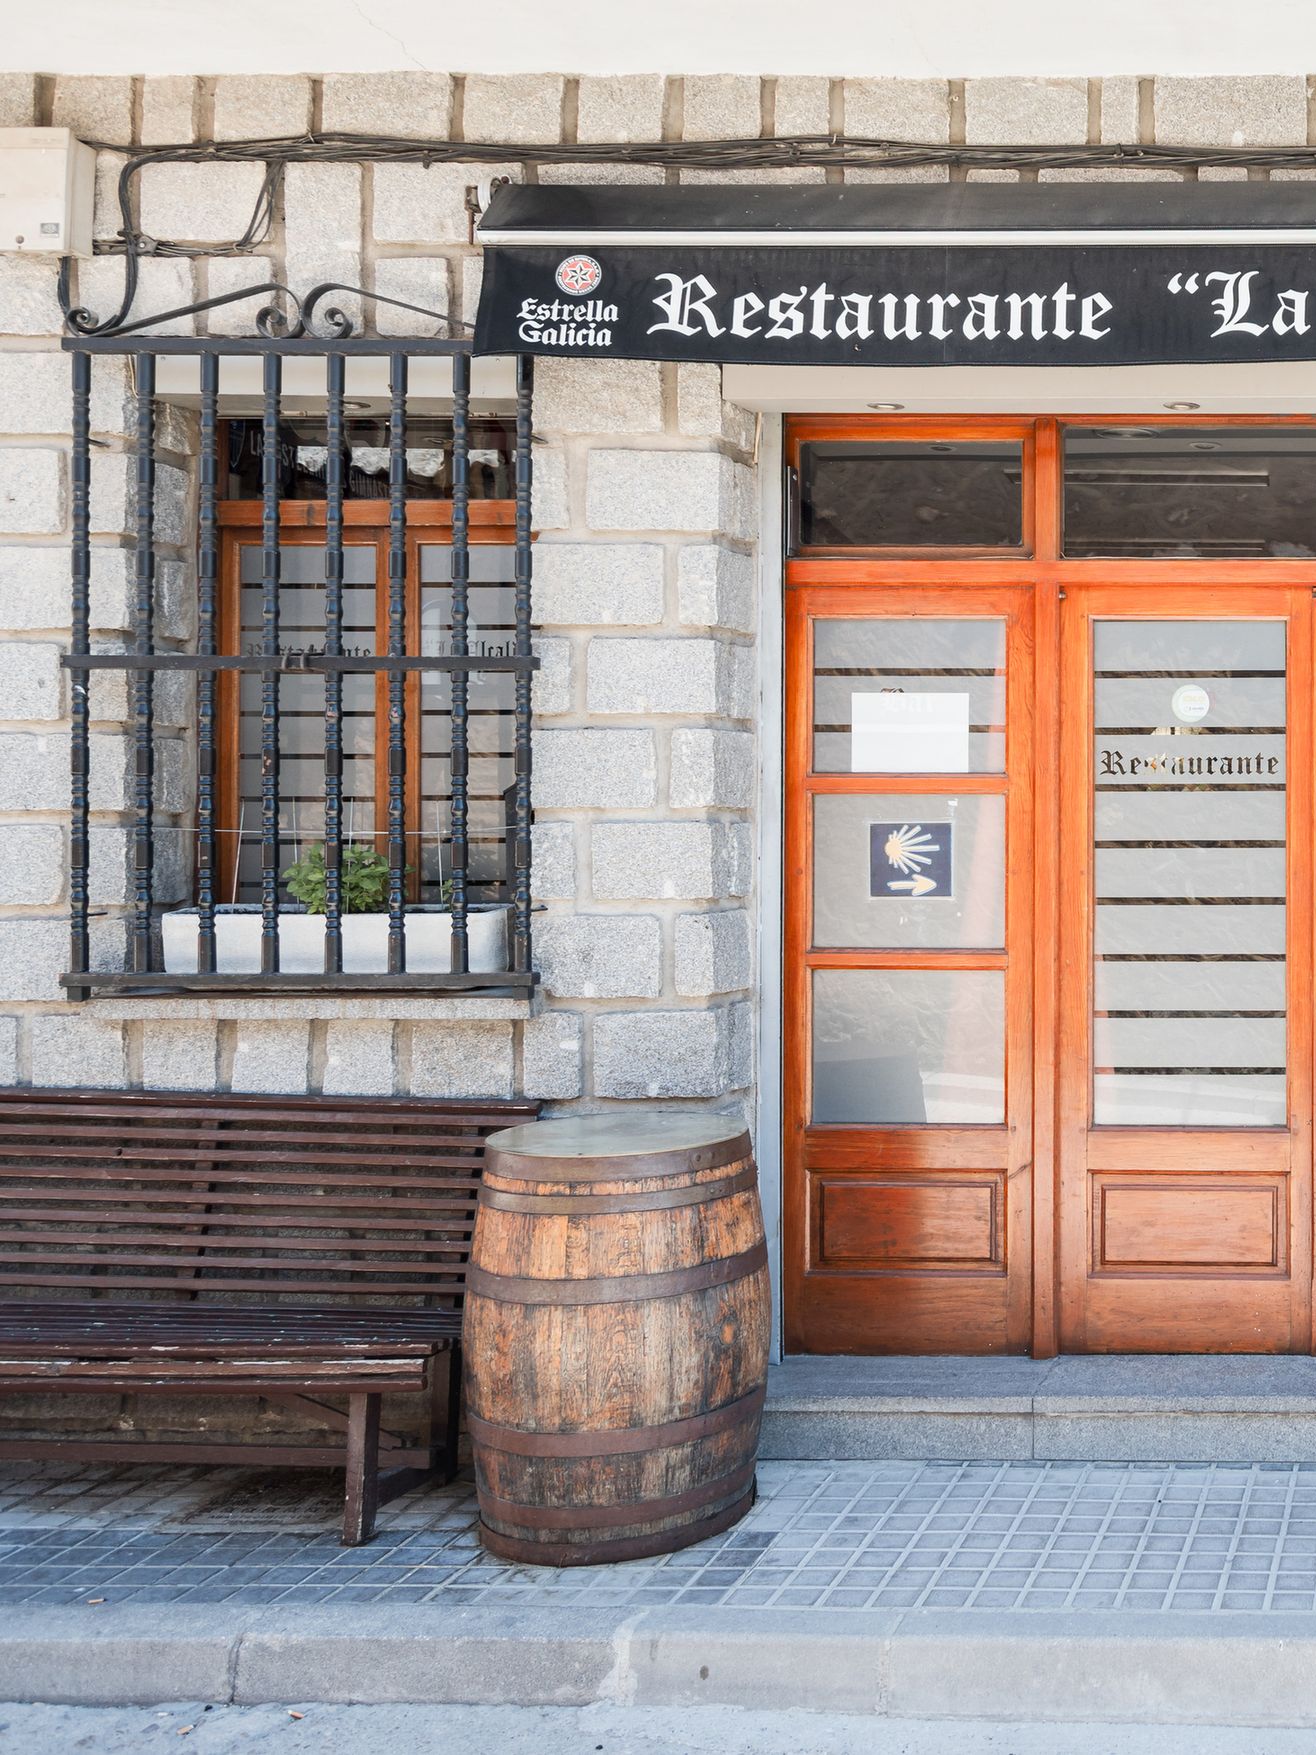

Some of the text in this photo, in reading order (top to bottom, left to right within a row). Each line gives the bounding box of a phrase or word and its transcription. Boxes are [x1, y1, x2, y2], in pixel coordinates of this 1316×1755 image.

[516, 297, 620, 322] Estrella
[646, 272, 1113, 341] Restaurante
[518, 320, 613, 347] Galicia
[1100, 750, 1279, 776] Restaurante
